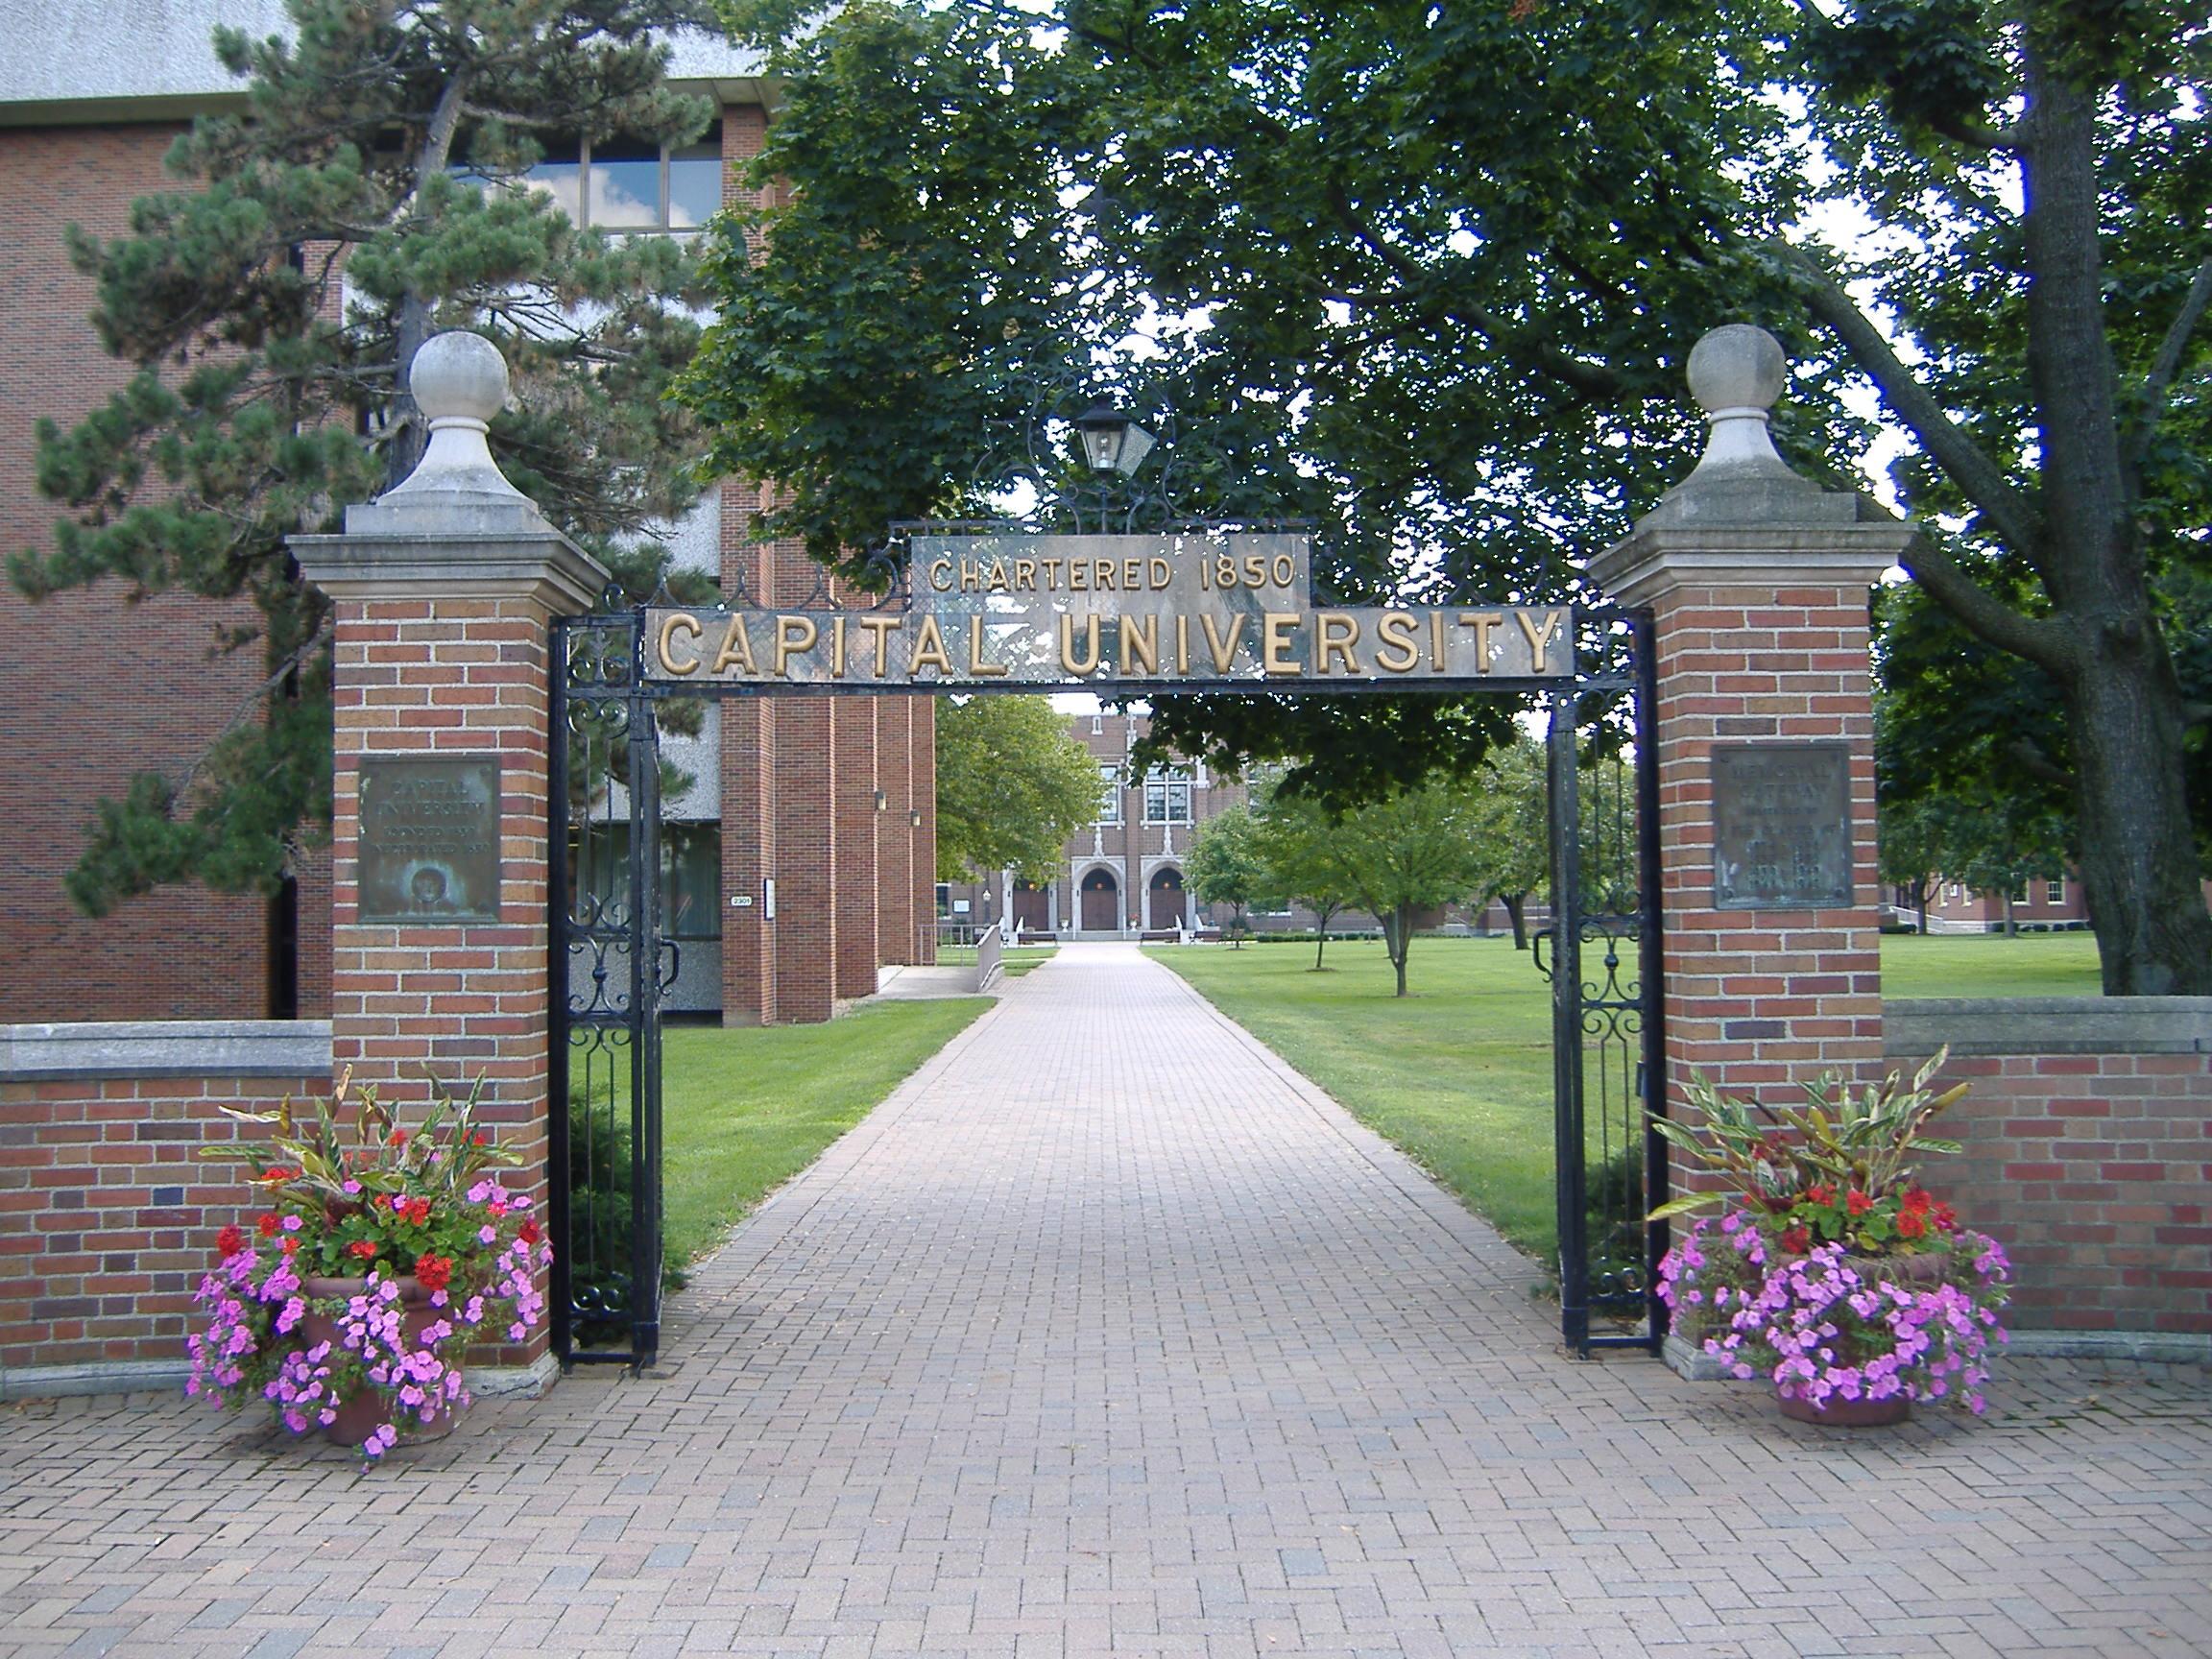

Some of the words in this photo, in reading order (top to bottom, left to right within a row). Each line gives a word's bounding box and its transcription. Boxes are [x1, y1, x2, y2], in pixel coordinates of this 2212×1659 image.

[928, 557, 1172, 591] CHARTERED
[1199, 554, 1296, 589] 1850
[657, 612, 1009, 678] CAPITAL
[1059, 611, 1561, 676] UNIVERSITY
